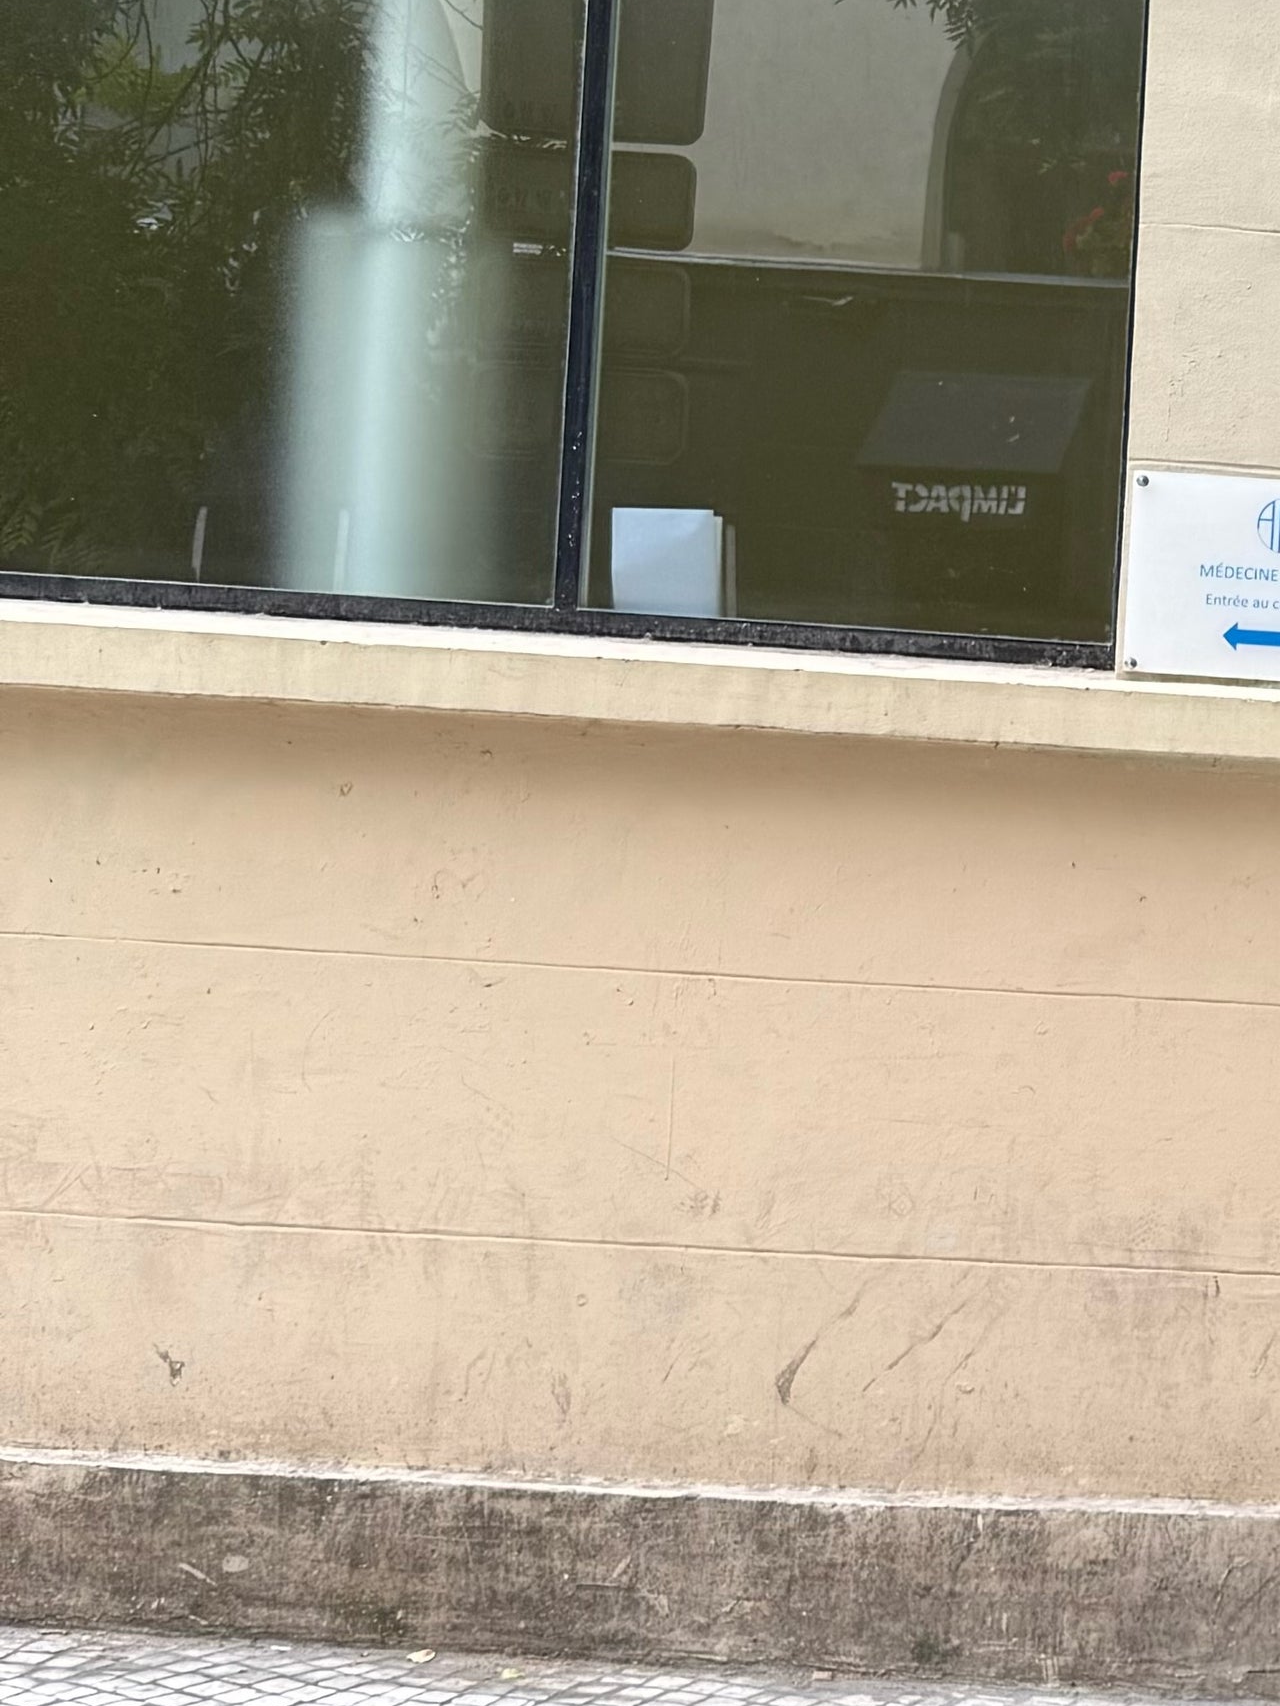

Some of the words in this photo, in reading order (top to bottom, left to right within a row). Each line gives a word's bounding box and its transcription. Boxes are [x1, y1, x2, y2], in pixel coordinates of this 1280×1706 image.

[1199, 563, 1279, 582] MÉDECINE
[1205, 593, 1249, 608] Entrée
[1252, 598, 1269, 610] au
